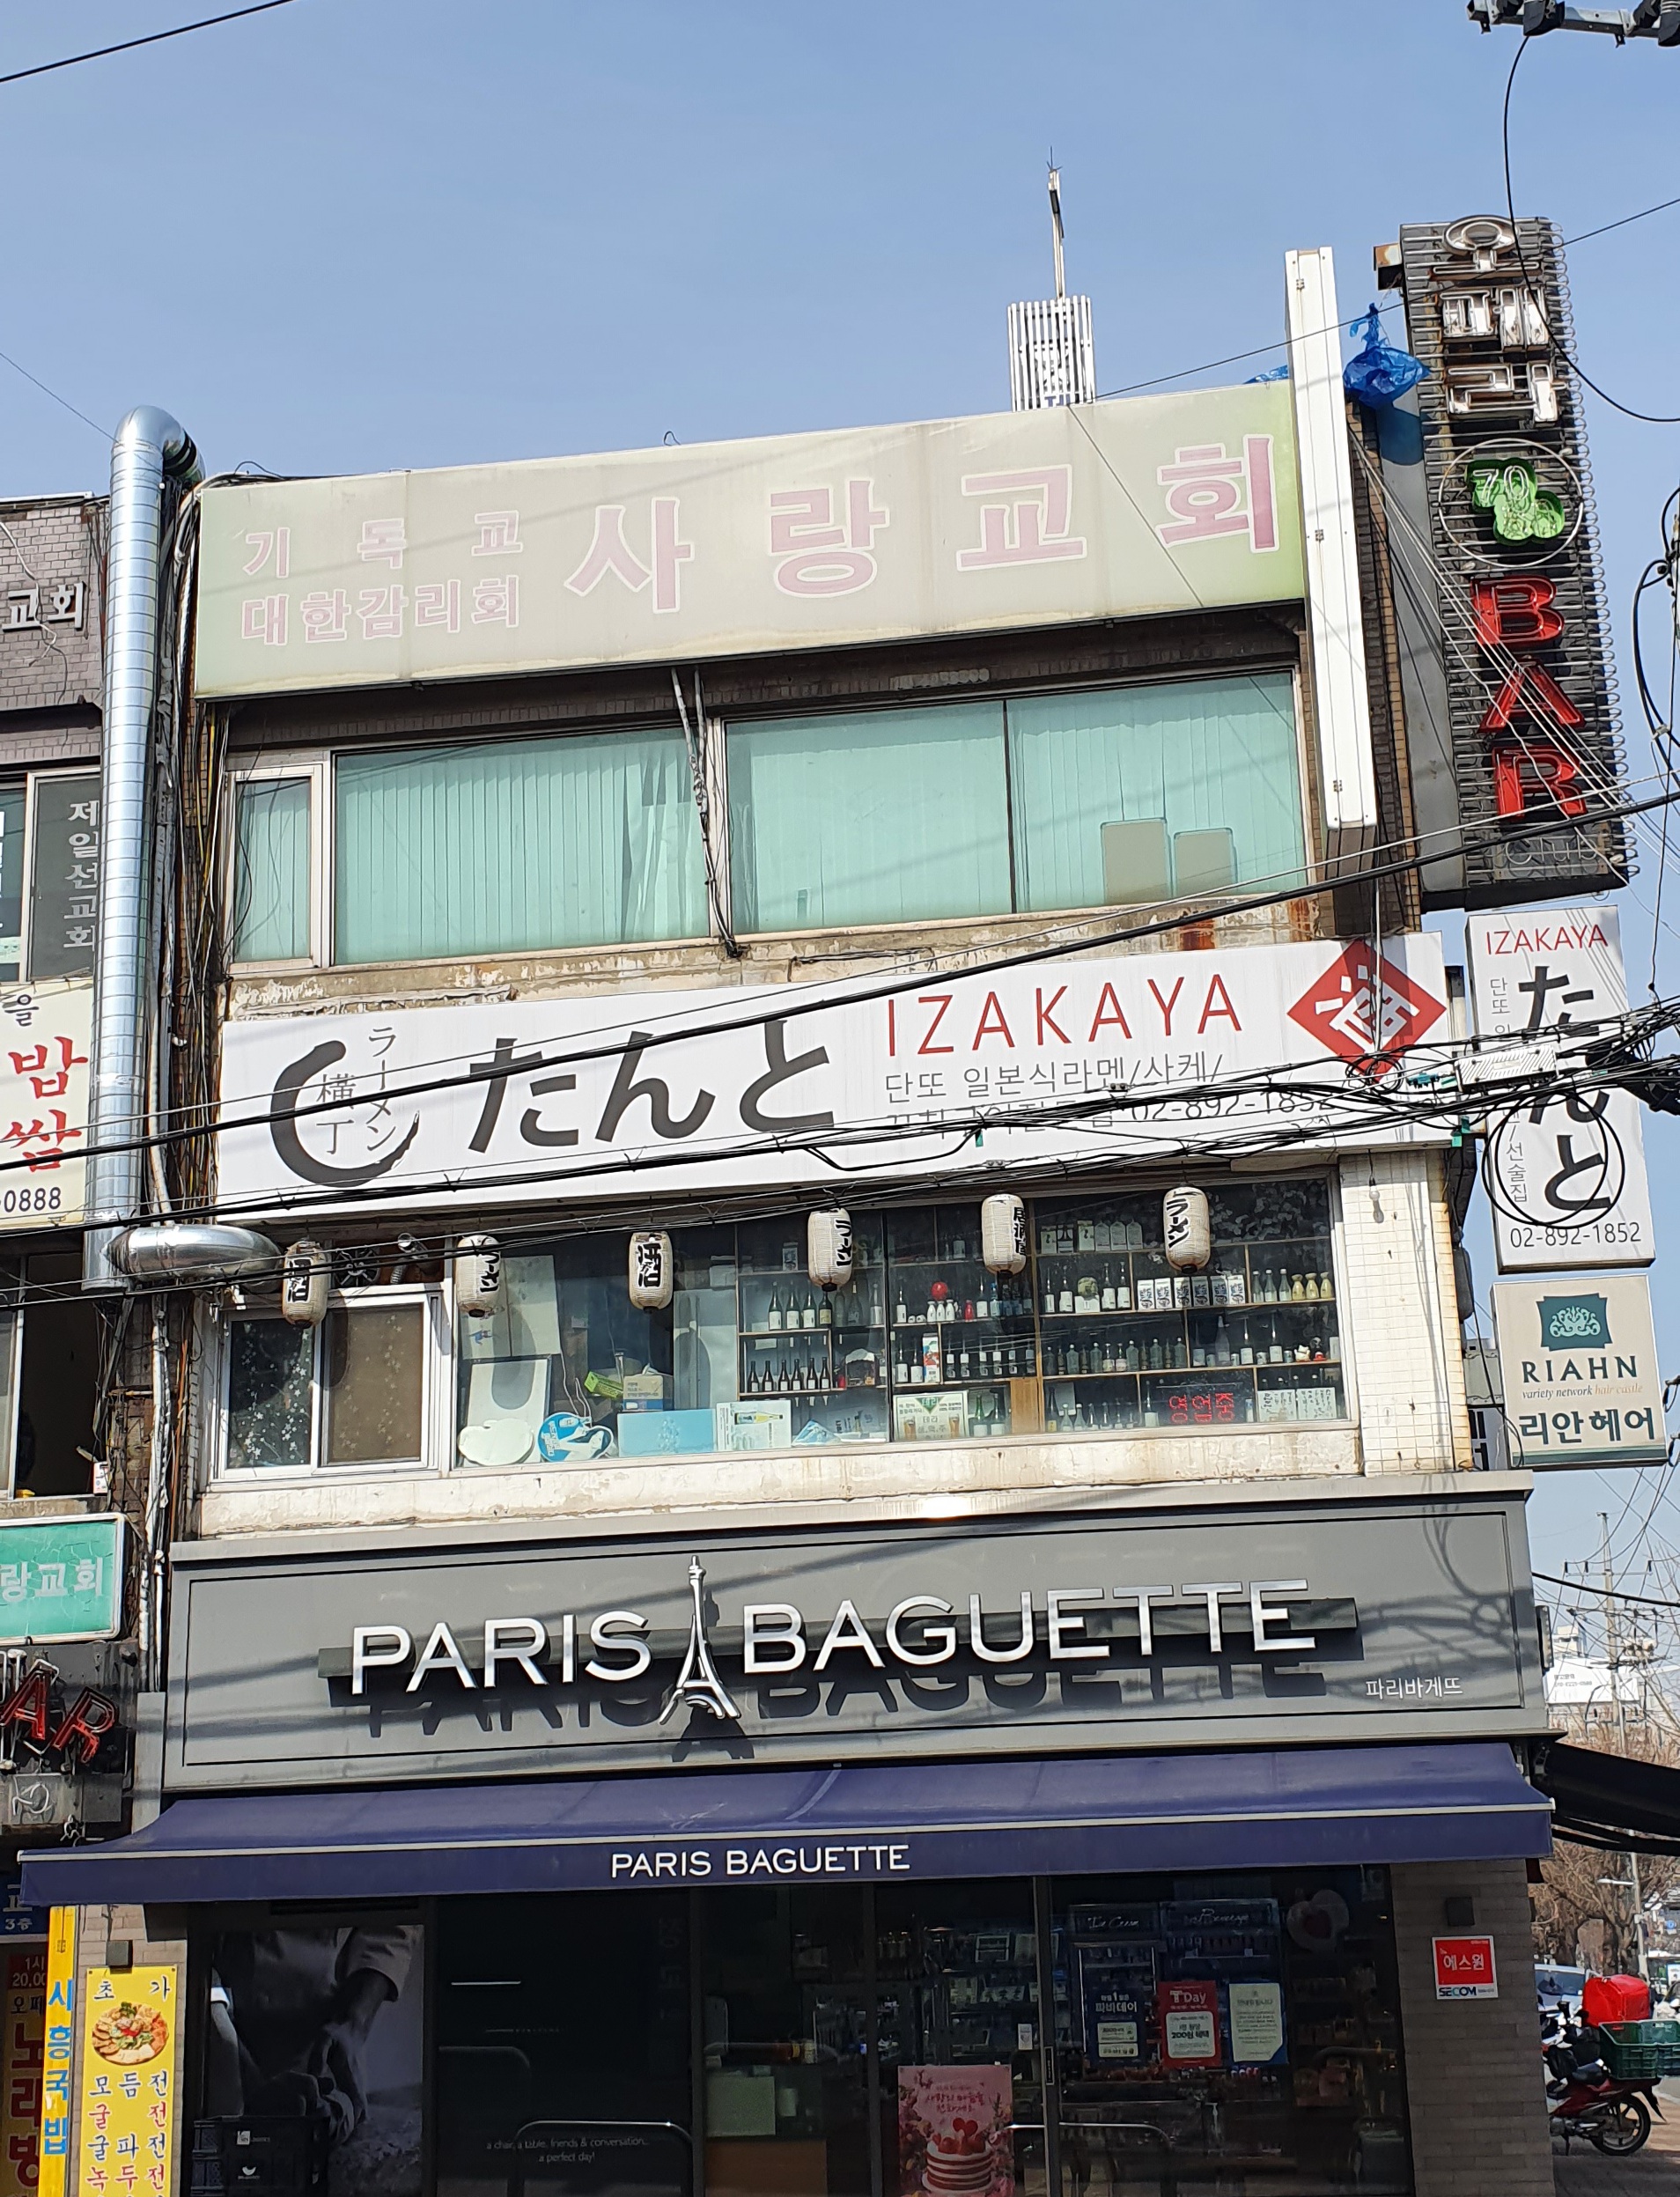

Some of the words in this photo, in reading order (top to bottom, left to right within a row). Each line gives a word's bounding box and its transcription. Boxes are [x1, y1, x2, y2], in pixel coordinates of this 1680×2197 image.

[564, 434, 1279, 615] 사랑교회
[242, 510, 523, 579] 기독교
[1, 581, 85, 631] 교회
[241, 574, 519, 645] 대한감리회
[1470, 574, 1587, 821] BAR
[1486, 924, 1609, 955] IZAKAYA
[888, 973, 1243, 1057] IZAKAYA
[8, 1036, 88, 1100] 밥
[468, 1019, 835, 1154] たんと
[885, 1069, 947, 1105] 단또
[1510, 1221, 1642, 1250] 02-892-1852
[1522, 1356, 1638, 1383] RIAHN
[1522, 1388, 1554, 1401] variety
[1556, 1385, 1593, 1398] network
[1595, 1383, 1614, 1396] hair
[1519, 1407, 1655, 1445] 리안헤어
[352, 1610, 653, 1696] PARIS
[742, 1578, 1318, 1677] BAGUETTE
[1366, 1676, 1463, 1700] 파리바게뜨
[611, 1851, 712, 1878] PARIS
[726, 1844, 910, 1876] BAGUETTE
[1443, 1952, 1485, 1971] 에스원
[1439, 1986, 1477, 1996] SECOM
